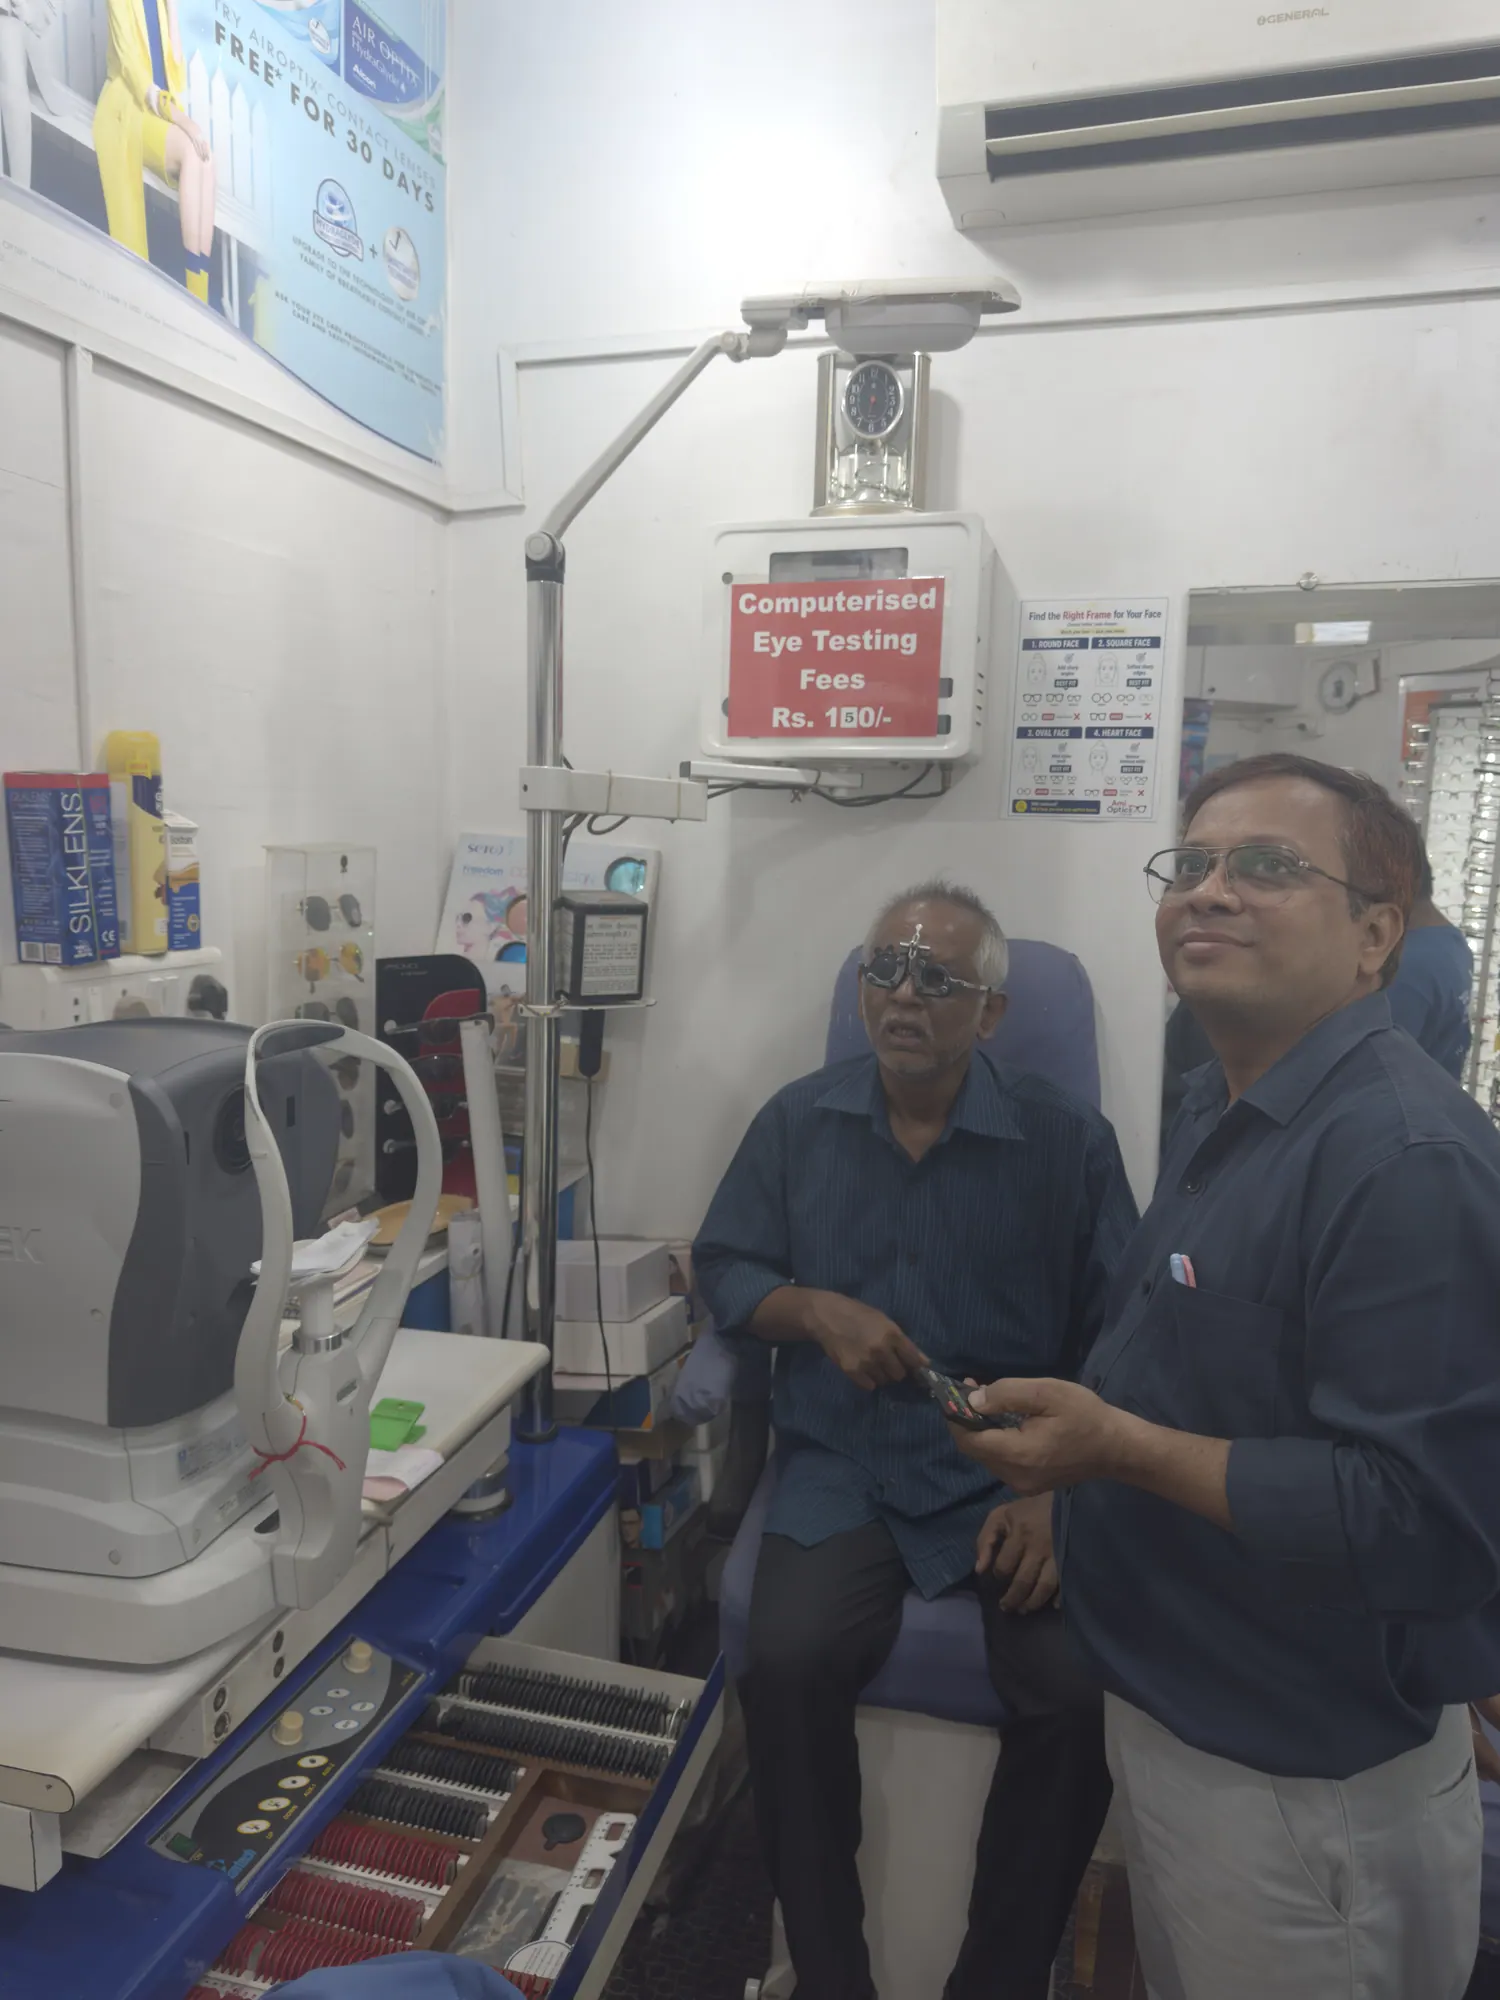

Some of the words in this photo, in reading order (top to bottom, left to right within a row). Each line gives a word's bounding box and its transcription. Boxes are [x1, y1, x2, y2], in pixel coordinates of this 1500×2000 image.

[352, 16, 376, 48] AIR
[214, 0, 241, 29] TRY
[327, 92, 389, 150] CONTACT
[394, 148, 436, 190] LENSES
[290, 82, 336, 138] FOR
[346, 130, 373, 163] 30
[382, 157, 435, 213] DAYS
[739, 587, 937, 618] Computerised
[1029, 611, 1046, 621] Find
[1048, 611, 1061, 621] the
[1062, 610, 1085, 622] Right
[1086, 610, 1112, 620] Frame
[1113, 609, 1125, 619] for
[1126, 609, 1143, 619] Your
[1144, 609, 1162, 619] Face
[753, 631, 803, 658] Eye
[812, 629, 918, 656] Testing
[1038, 640, 1062, 648] ROUND
[1063, 640, 1080, 648] FACE
[1106, 638, 1133, 647] SQUARE
[1134, 638, 1151, 647] FACE
[800, 668, 866, 690] Fees
[772, 706, 814, 728] Rs.
[825, 706, 892, 728] 150/-
[1035, 729, 1052, 737] OVAL
[1053, 729, 1070, 737] FACE
[1102, 729, 1123, 737] HEART
[1125, 729, 1142, 737] FACE
[1106, 806, 1133, 814] Optics
[61, 791, 93, 934] SILKLENS
[462, 865, 504, 877] Freedom
